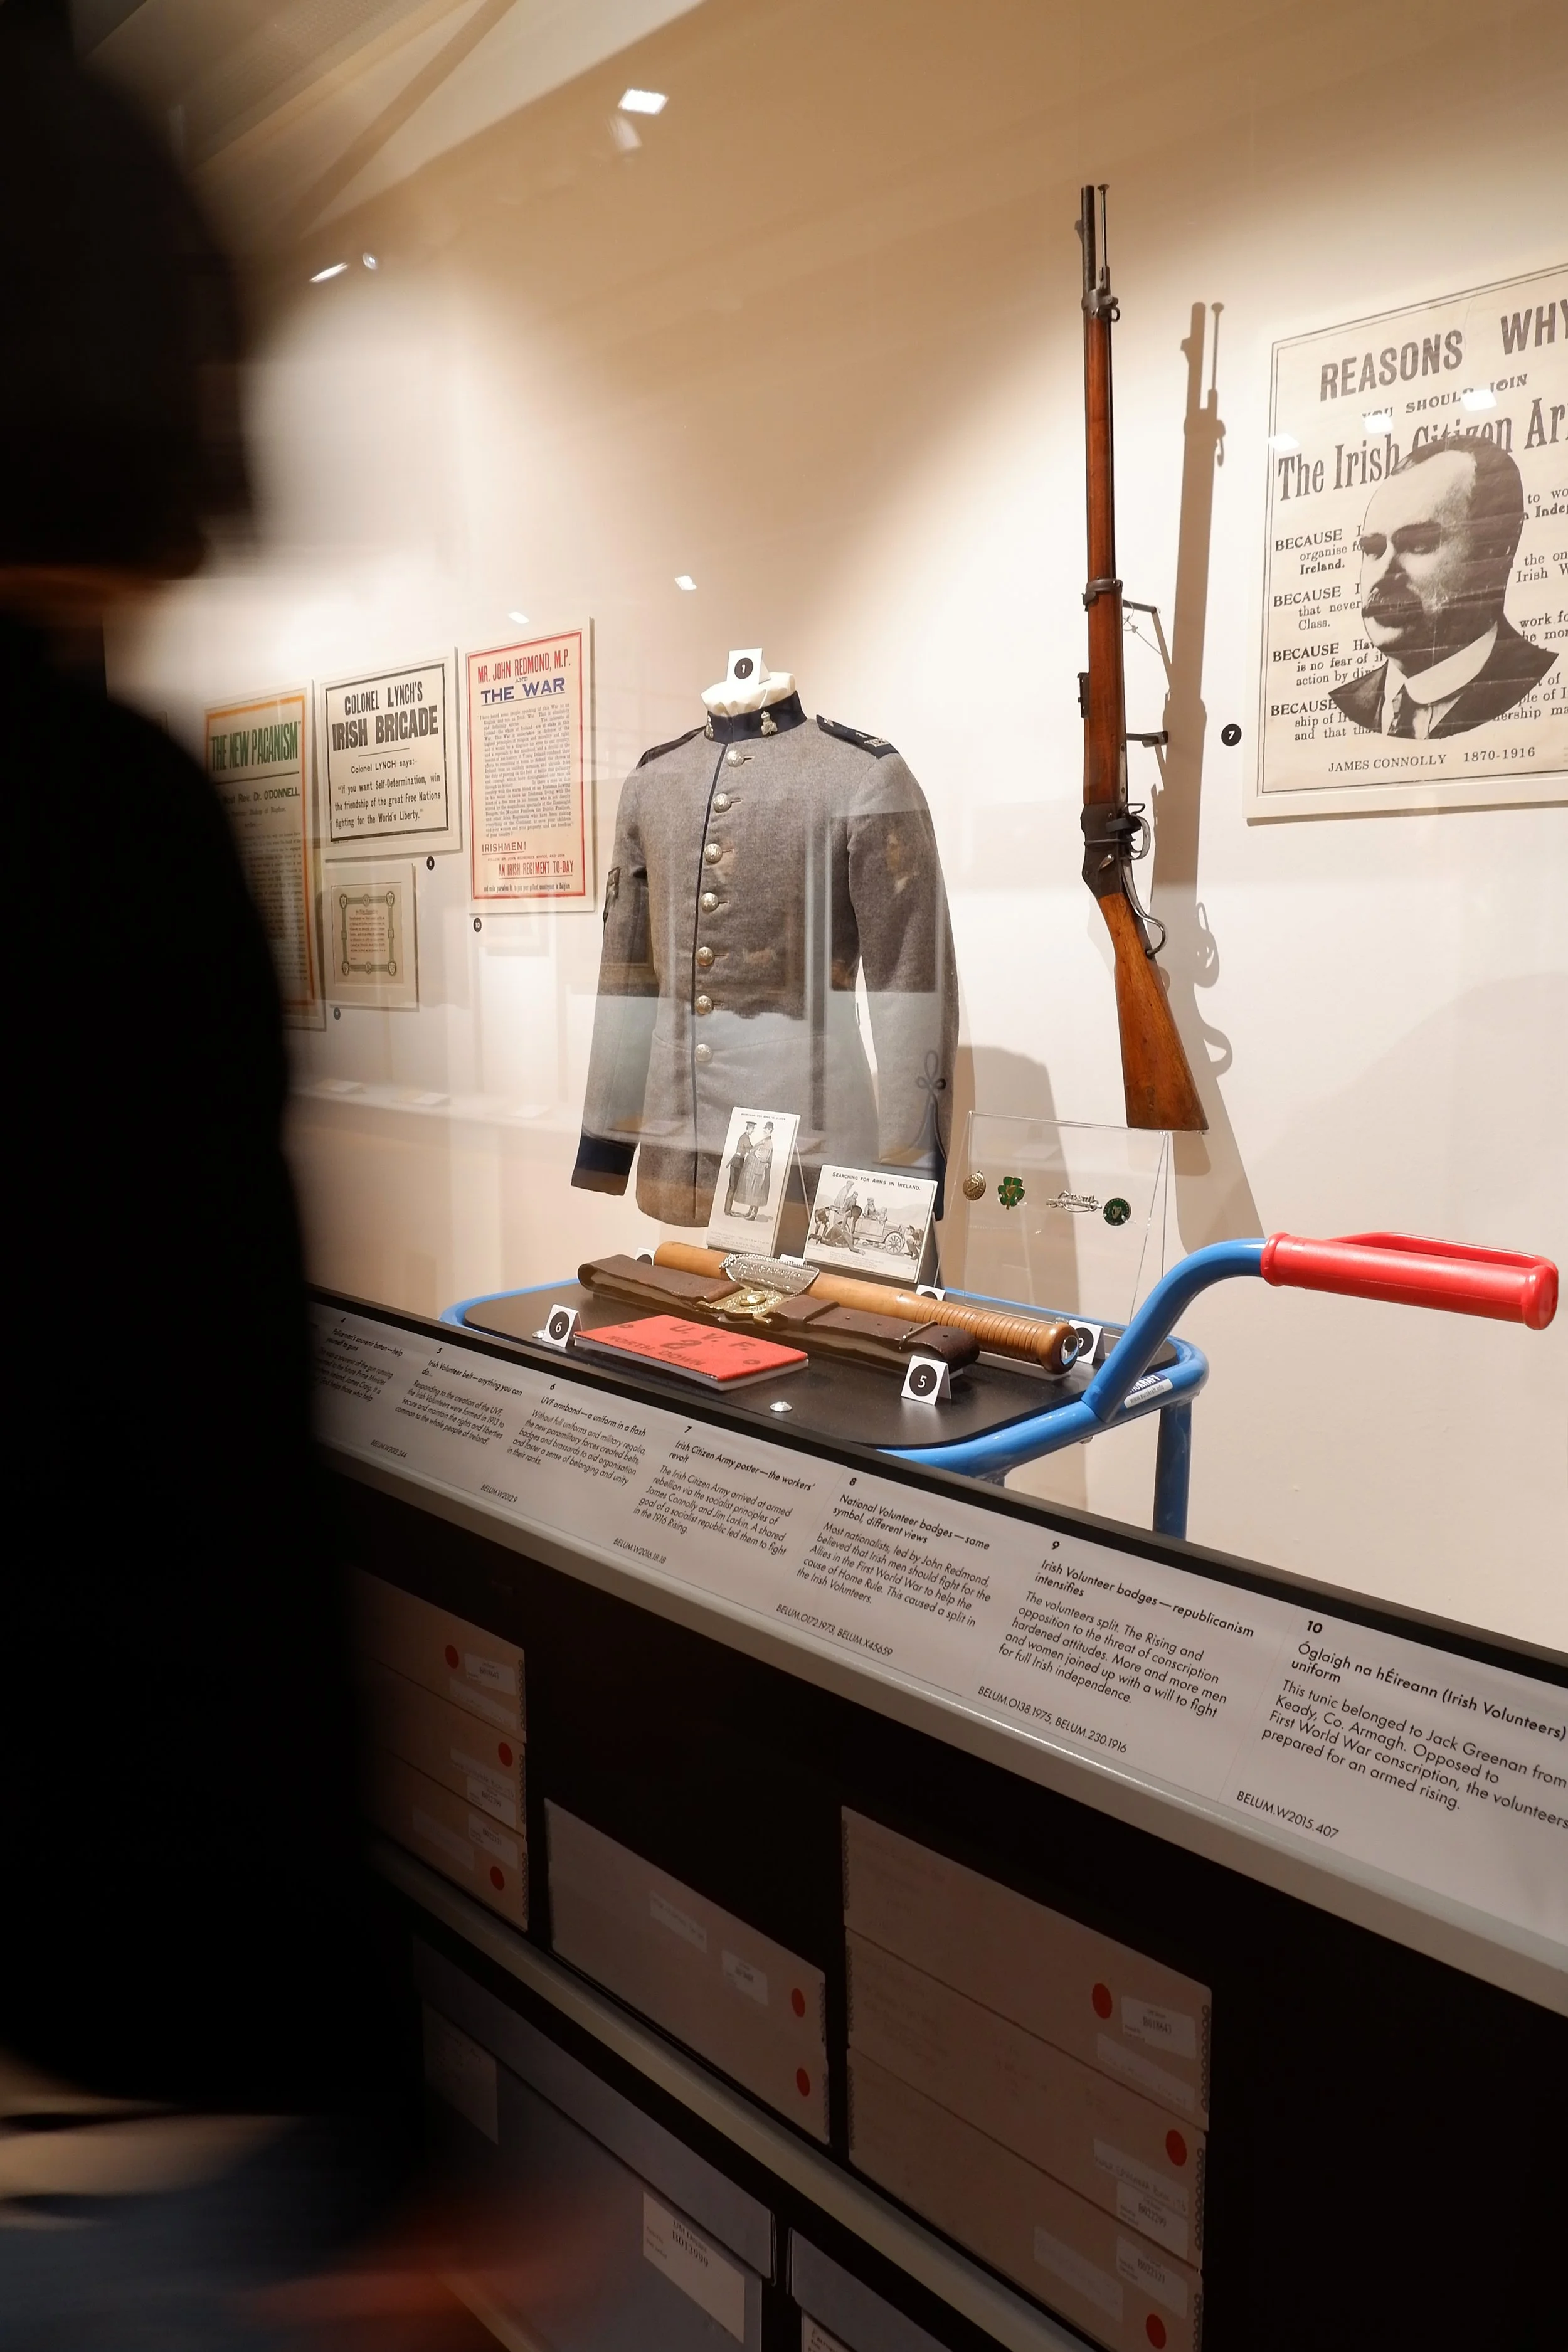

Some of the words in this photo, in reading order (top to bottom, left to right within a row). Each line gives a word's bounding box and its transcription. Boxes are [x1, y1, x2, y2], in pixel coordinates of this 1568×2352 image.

[1320, 329, 1463, 401] REASONS
[1500, 299, 1568, 355] WHY
[1278, 453, 1324, 501] The
[1333, 433, 1399, 490] Irish
[1527, 494, 1540, 504] to
[1276, 529, 1342, 551] BECAUSE
[1300, 544, 1347, 561] organise
[1524, 553, 1544, 566] the
[1300, 558, 1345, 575] Ireland.
[1516, 567, 1548, 583] Irish
[1274, 586, 1342, 607] BECAUSE
[1299, 605, 1320, 617] that
[1329, 600, 1362, 613] never
[1299, 620, 1330, 630] Class.
[1519, 613, 1551, 627] work
[1273, 643, 1339, 662] BECAUSE
[1297, 662, 1306, 672] is
[1310, 662, 1323, 670] no
[1330, 658, 1352, 668] fear
[1357, 652, 1368, 664] of
[478, 665, 490, 684] MR.
[493, 660, 511, 681] JOHN
[515, 653, 551, 677] REDMOND,
[554, 649, 571, 669] M.P.
[1296, 674, 1329, 686] action
[1335, 670, 1348, 683] by
[345, 690, 379, 715] COLONEL
[388, 681, 422, 707] LYNCH'S
[481, 686, 514, 704] THE
[522, 677, 565, 697] WAR
[1271, 699, 1338, 716] BECAUSE
[332, 719, 368, 751] IRISH
[376, 705, 438, 744] BRIGADE
[1295, 716, 1318, 729] ship
[1323, 713, 1333, 724] of
[1228, 730, 1235, 739] 7
[1295, 728, 1315, 741] and
[1324, 727, 1346, 738] that
[211, 735, 227, 771] THE
[230, 731, 249, 768] NEW
[1328, 760, 1370, 772] JAMES
[1373, 754, 1447, 769] CONNOLLY
[1463, 746, 1536, 763] 1870-1916
[351, 763, 372, 774] Colonel
[375, 760, 396, 770] LYNCH
[359, 783, 373, 792] want
[375, 775, 426, 790] Self-Determination,
[430, 773, 440, 782] win
[238, 794, 251, 802] Rev.
[344, 799, 368, 810] friendship
[371, 797, 376, 807] of
[378, 797, 386, 806] the
[389, 794, 403, 807] great
[405, 793, 416, 803] Free
[419, 792, 440, 801] Nations
[336, 817, 354, 829] fighting
[378, 812, 396, 822] World's
[499, 864, 504, 876] AN
[507, 862, 520, 876] IRISH
[523, 861, 549, 875] REGIMENT
[553, 861, 573, 874] TO-DAY
[555, 1322, 563, 1333] 6
[659, 1350, 706, 1366] DOWN
[918, 1375, 927, 1387] 5
[849, 1478, 857, 1486] 8
[840, 1494, 878, 1513] National
[879, 1506, 918, 1526] Volunteer
[833, 1508, 864, 1524] symbol,
[867, 1516, 903, 1535] different
[904, 1529, 928, 1544] views
[1051, 1541, 1060, 1550] 9
[1035, 1572, 1084, 1597] intensifies
[1041, 1559, 1062, 1574] Irish
[1067, 1567, 1115, 1591] Volunteer
[1026, 1591, 1042, 1605] The
[1046, 1601, 1094, 1623] volunteers
[1096, 1619, 1118, 1633] split.
[1125, 1624, 1142, 1640] The
[1145, 1632, 1177, 1655] Rising
[1180, 1648, 1204, 1661] and
[1307, 1620, 1323, 1634] 10
[1019, 1608, 1070, 1631] opposition
[1073, 1624, 1083, 1634] to
[1085, 1628, 1101, 1641] the
[1104, 1634, 1136, 1653] threat
[1138, 1648, 1152, 1658] of
[1152, 1655, 1218, 1683] conscription
[1012, 1616, 1062, 1643] hardened
[1062, 1639, 1108, 1661] attitudes.
[1111, 1653, 1141, 1672] More
[1144, 1668, 1168, 1682] and
[1169, 1677, 1198, 1693] more
[1202, 1689, 1227, 1703] men
[1291, 1661, 1340, 1683] uniform
[1298, 1641, 1350, 1670] Óglaigh
[1355, 1665, 1372, 1676] na
[1376, 1667, 1438, 1698] hÉireann
[1443, 1688, 1477, 1711] (Irish
[1484, 1702, 1566, 1742] Volunteers)
[1276, 1695, 1317, 1721] Keady,
[1324, 1712, 1343, 1729] Co.
[1348, 1722, 1406, 1751] Armagh.
[1414, 1744, 1482, 1777] Opposed
[1485, 1770, 1499, 1783] to
[1283, 1679, 1305, 1697] This
[1308, 1690, 1338, 1708] tunic
[1341, 1698, 1407, 1732] belonged
[1409, 1725, 1422, 1737] to
[1426, 1730, 1458, 1751] Jack
[1463, 1742, 1527, 1775] Greenan
[1533, 1764, 1567, 1788] from
[1261, 1729, 1325, 1757] prepared
[1327, 1748, 1346, 1765] for
[1348, 1761, 1366, 1774] an
[1370, 1769, 1417, 1792] armed
[1420, 1787, 1459, 1811] rising.
[1269, 1710, 1295, 1729] First
[1300, 1720, 1340, 1745] World
[1344, 1735, 1372, 1756] War
[1375, 1752, 1459, 1791] conscription,
[1466, 1781, 1488, 1799] the
[1494, 1794, 1568, 1829] volunteers
